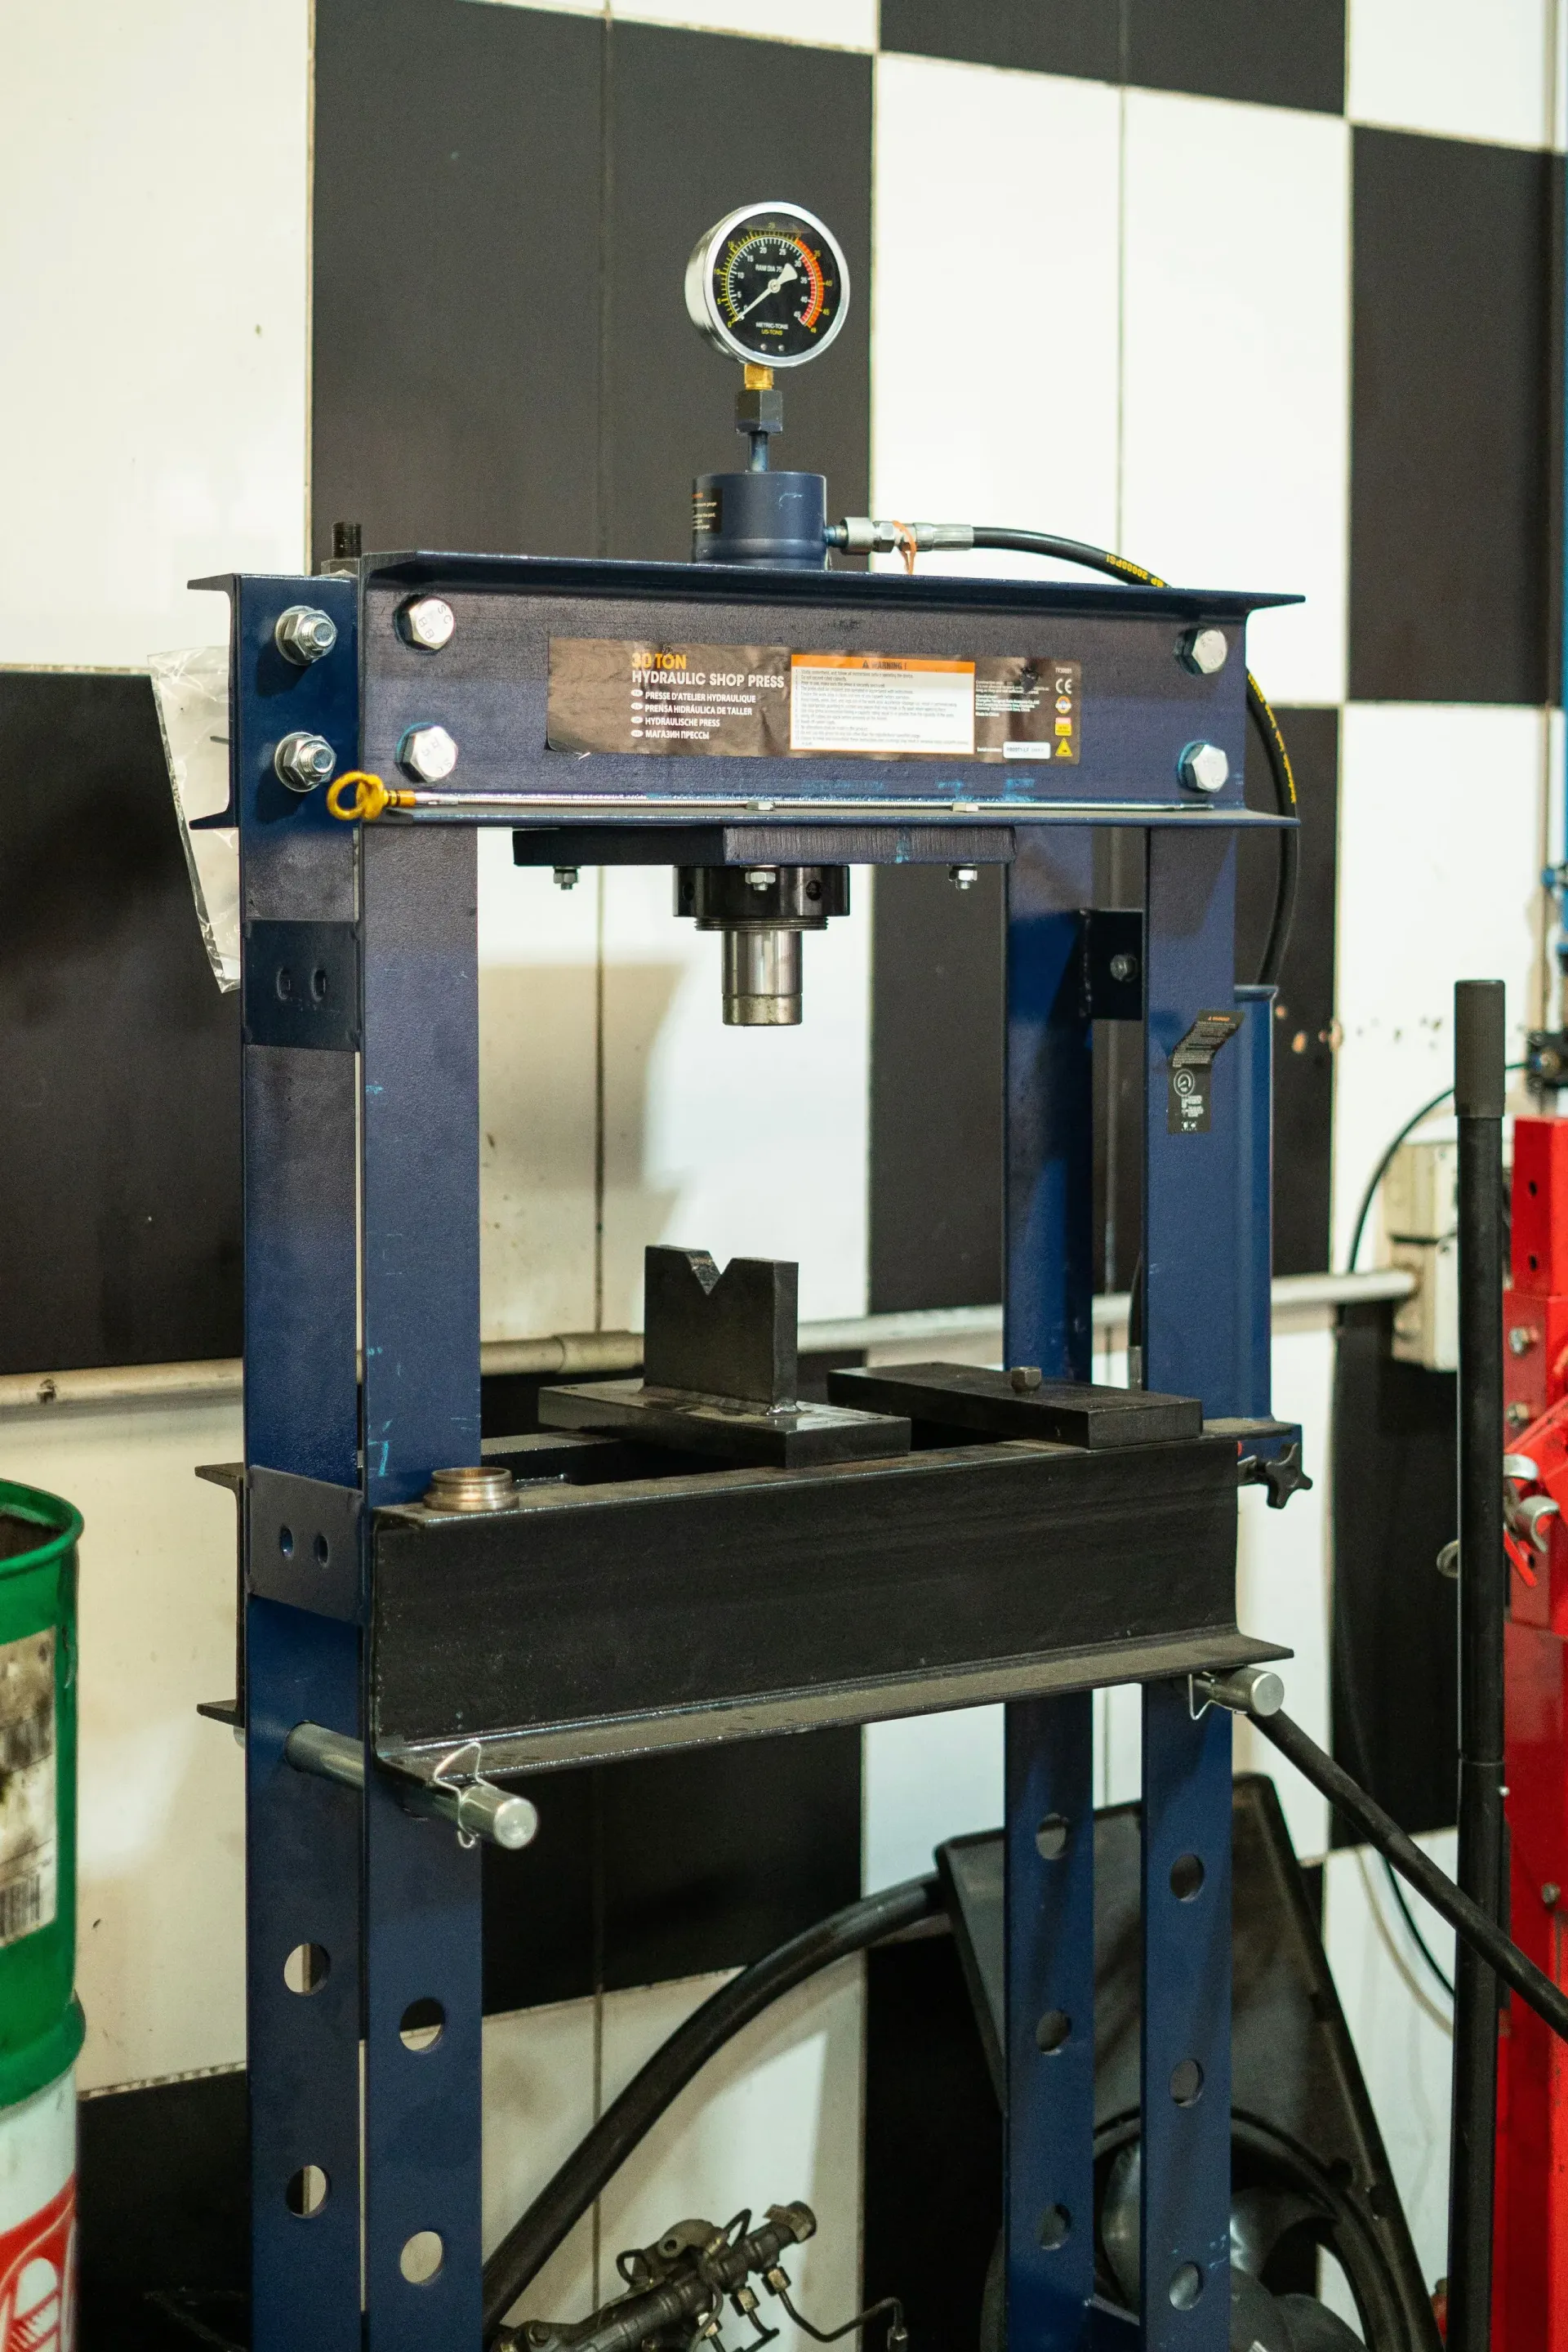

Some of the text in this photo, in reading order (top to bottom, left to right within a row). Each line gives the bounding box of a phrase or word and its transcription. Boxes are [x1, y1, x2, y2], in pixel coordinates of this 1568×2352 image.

[631, 652, 687, 670] 30 TON
[631, 670, 784, 688] HYDRAULIC SHOP PRESS
[1055, 678, 1072, 694] CE
[645, 691, 756, 703] PRESSE D'ATELIER HYDRAULIQUE
[645, 704, 753, 715] PRENSA HIDRÁULICA DE TALLER
[645, 717, 720, 727] HYDRAULISCHE PRESS
[645, 729, 710, 740] МАГАЗИН ПРЕССЫ
